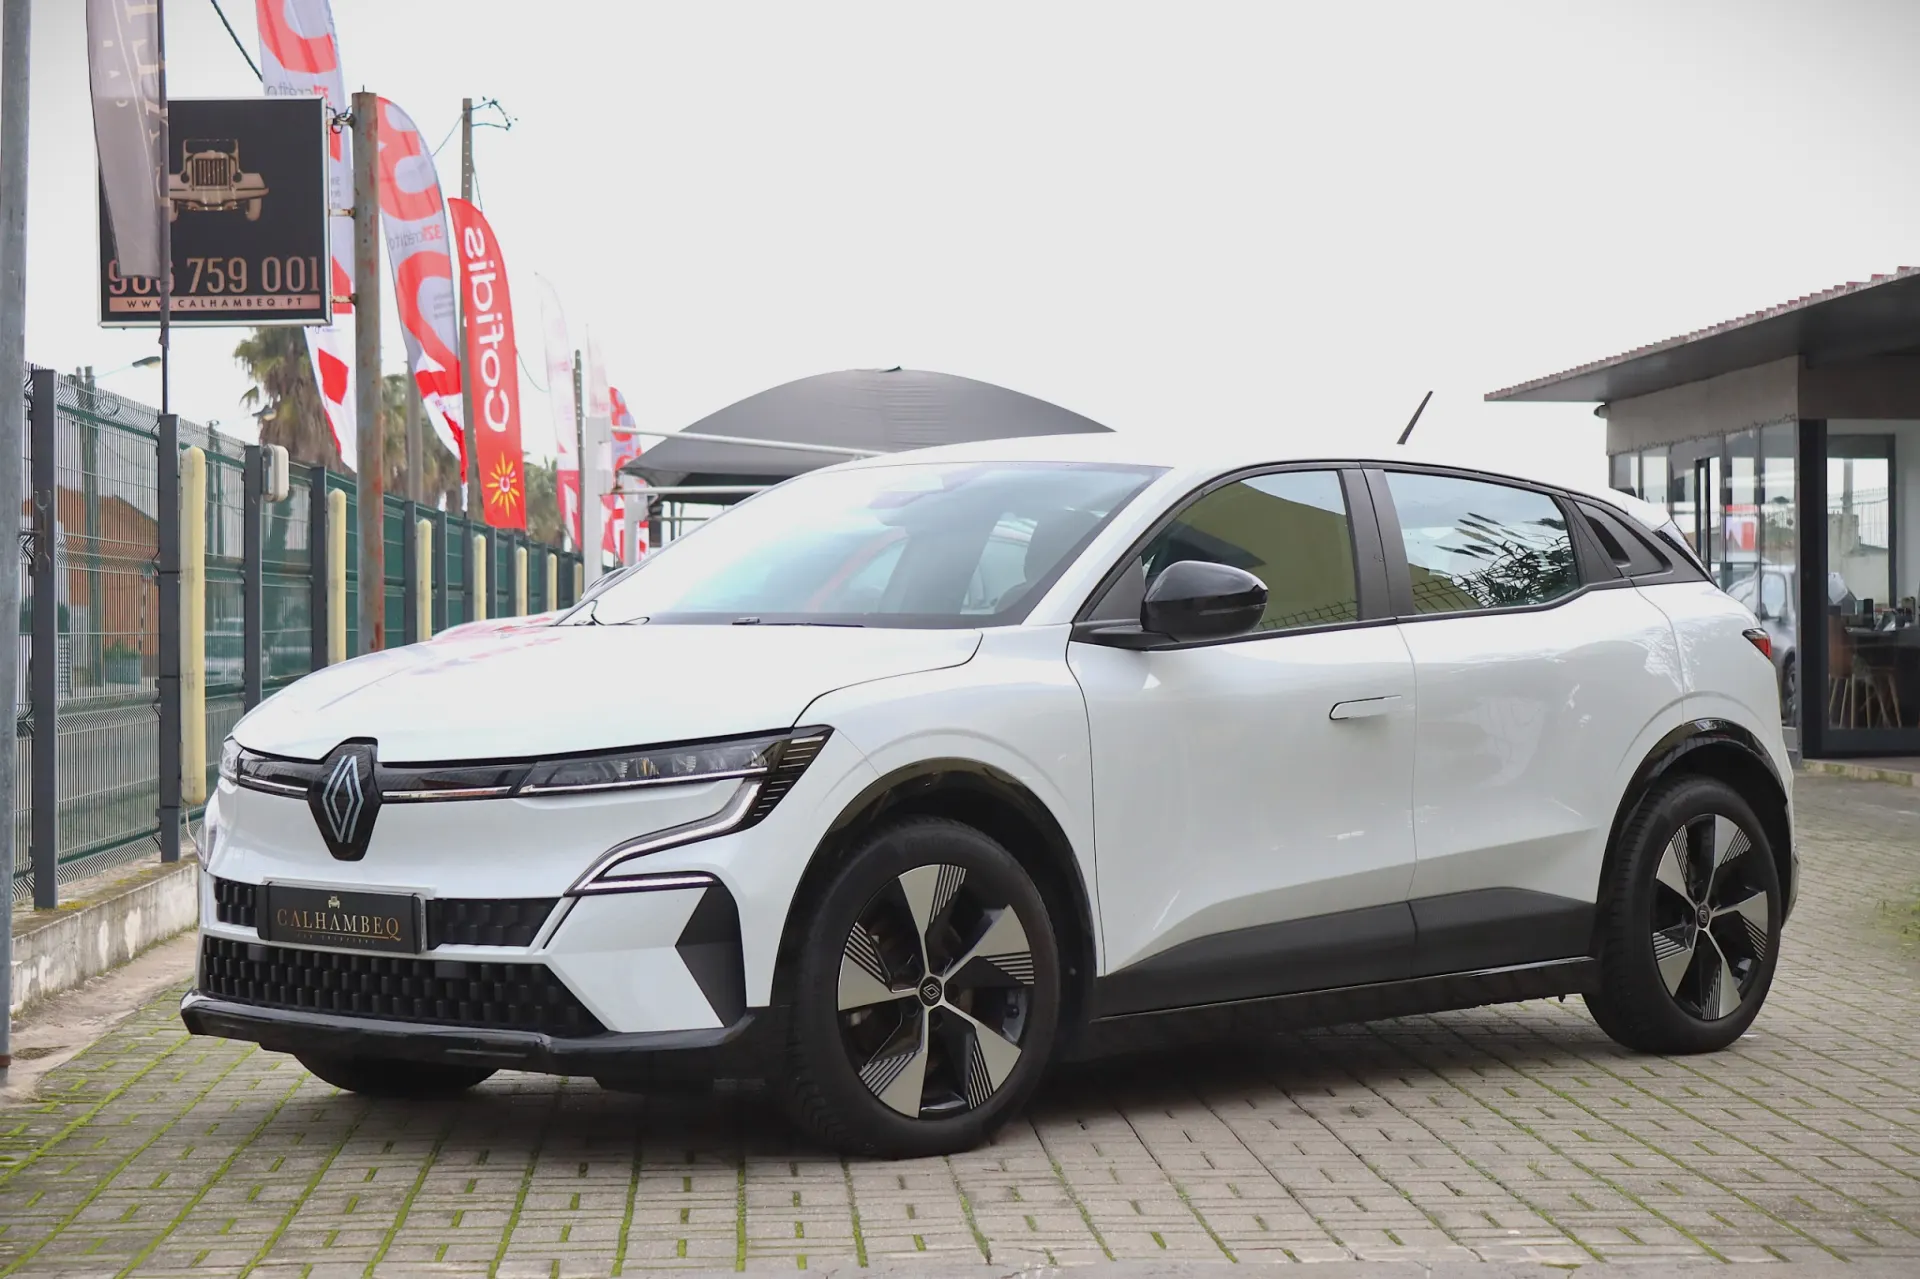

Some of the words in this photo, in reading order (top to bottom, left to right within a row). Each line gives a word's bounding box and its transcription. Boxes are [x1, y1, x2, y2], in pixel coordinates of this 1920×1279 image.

[186, 256, 248, 294] 759
[261, 255, 320, 292] 001
[277, 908, 401, 941] CALHAMBEQ
